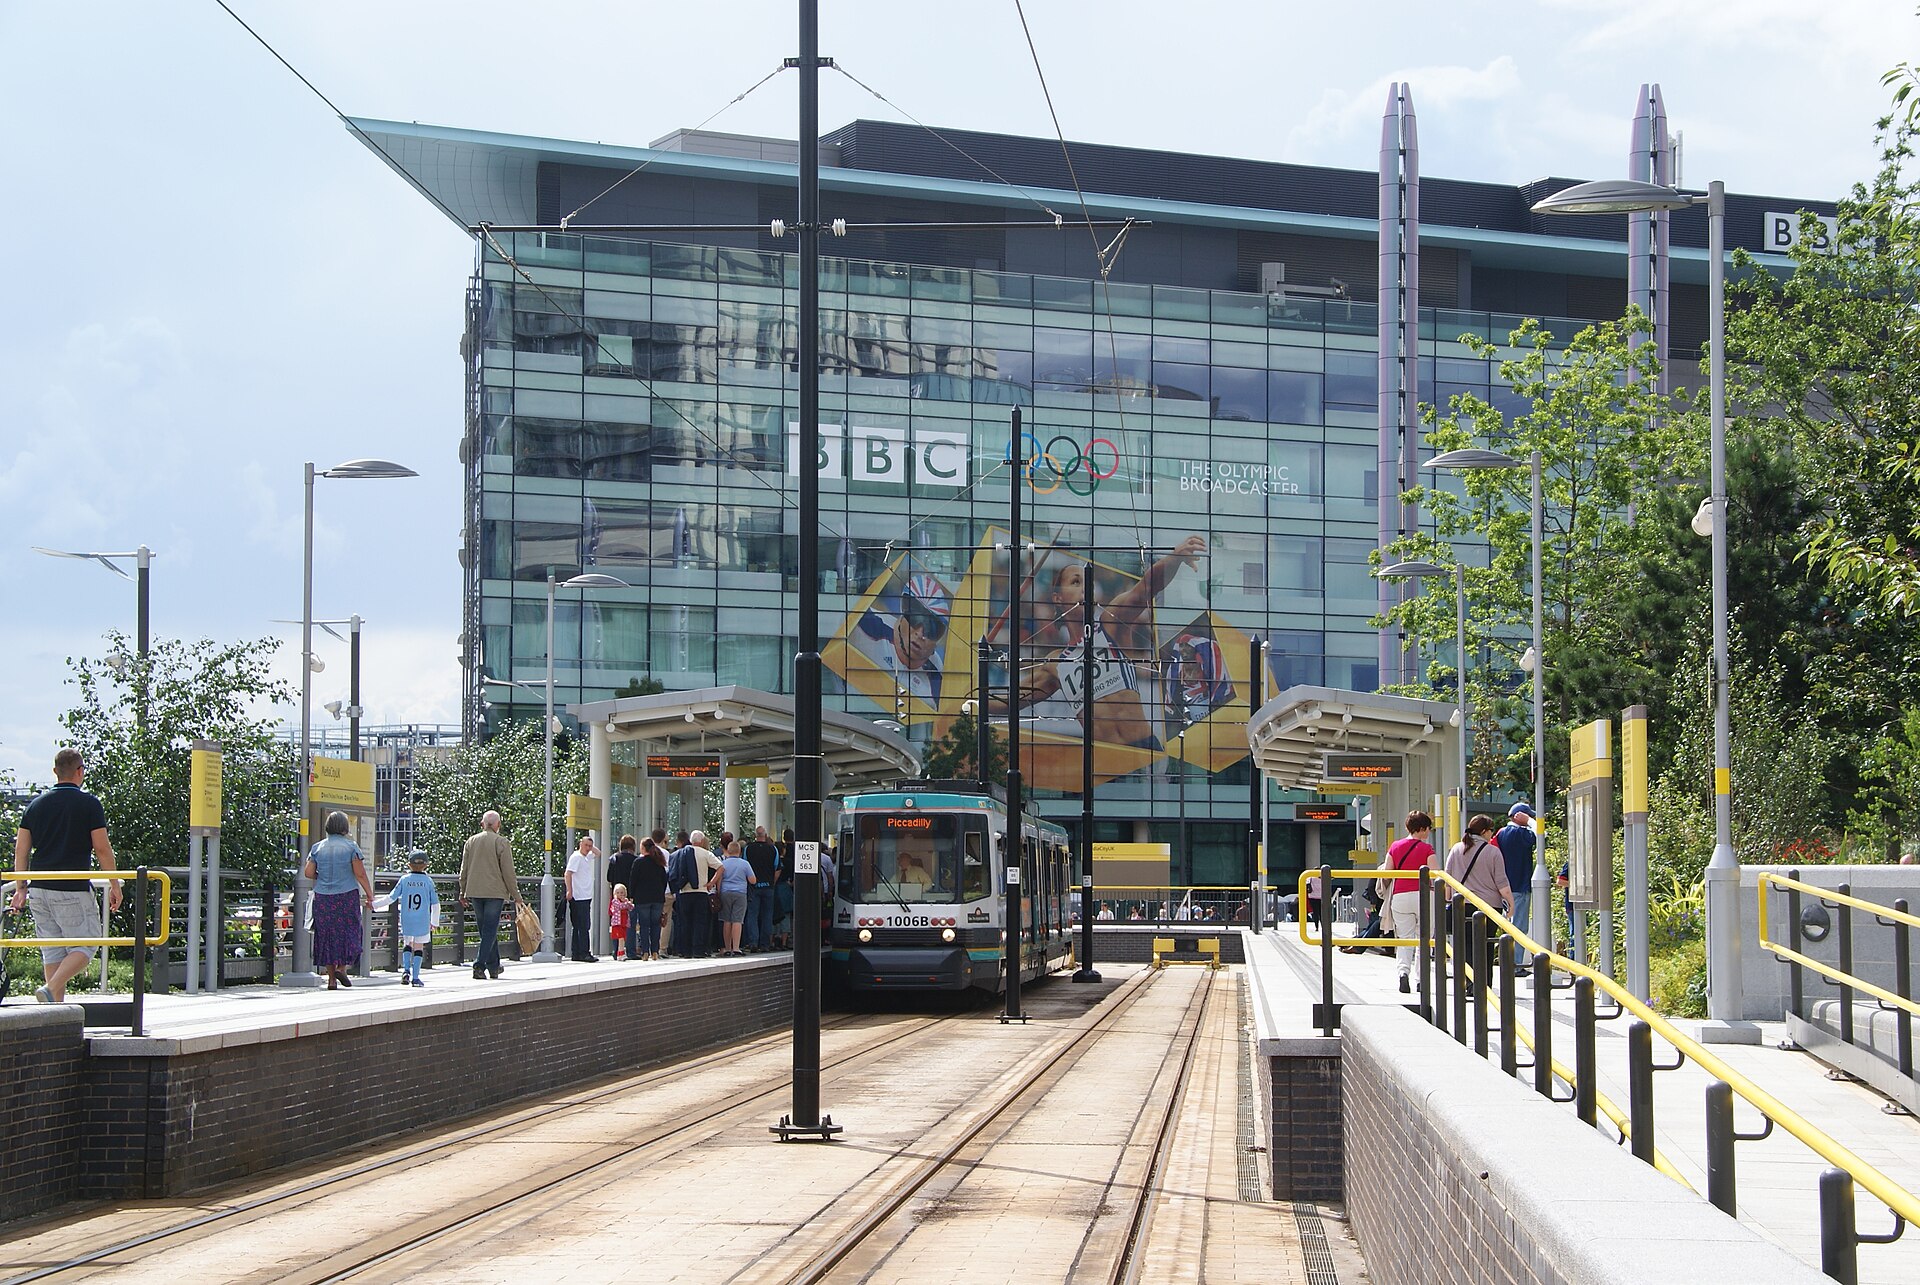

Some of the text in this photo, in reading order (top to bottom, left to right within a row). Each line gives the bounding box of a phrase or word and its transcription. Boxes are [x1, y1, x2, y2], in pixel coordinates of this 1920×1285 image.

[1180, 460, 1289, 480] THE OLYMPIC
[1180, 477, 1299, 495] BROADCASTER
[887, 817, 932, 829] Piccadilly
[801, 853, 811, 861] 05
[408, 893, 422, 910] 19
[886, 915, 929, 927] 1006B
